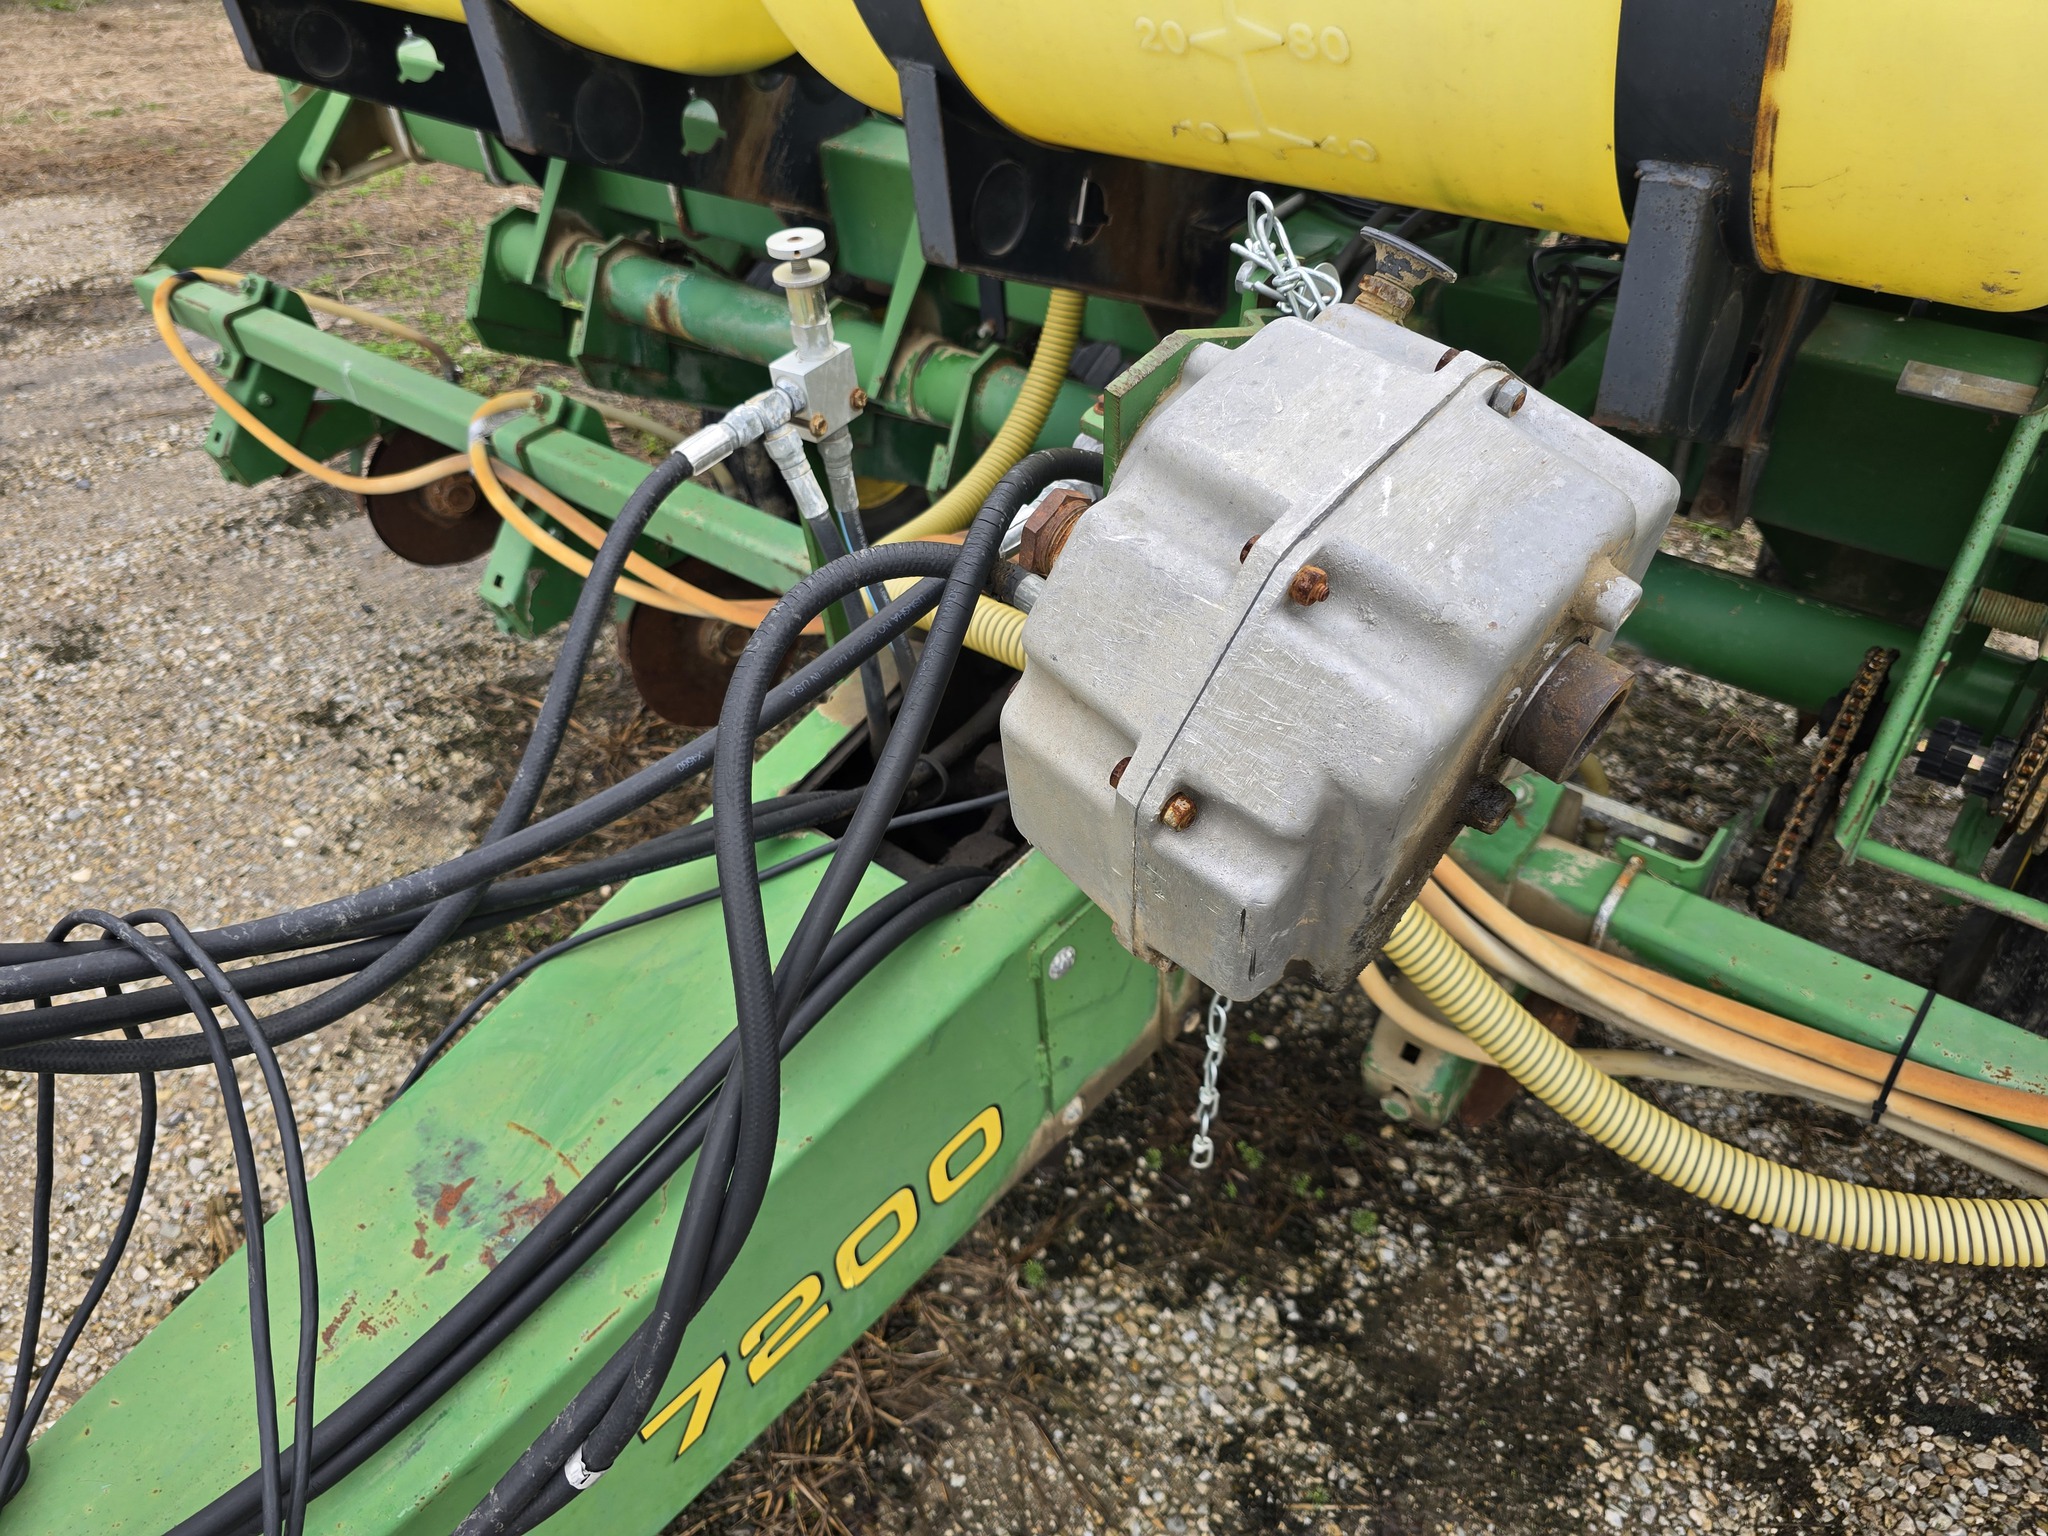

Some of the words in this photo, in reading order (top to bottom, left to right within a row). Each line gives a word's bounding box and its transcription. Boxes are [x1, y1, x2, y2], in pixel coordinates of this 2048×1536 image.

[1134, 16, 1187, 55] 20
[1287, 21, 1350, 64] 80
[810, 672, 823, 682] IN
[637, 1103, 1003, 1461] 7200
